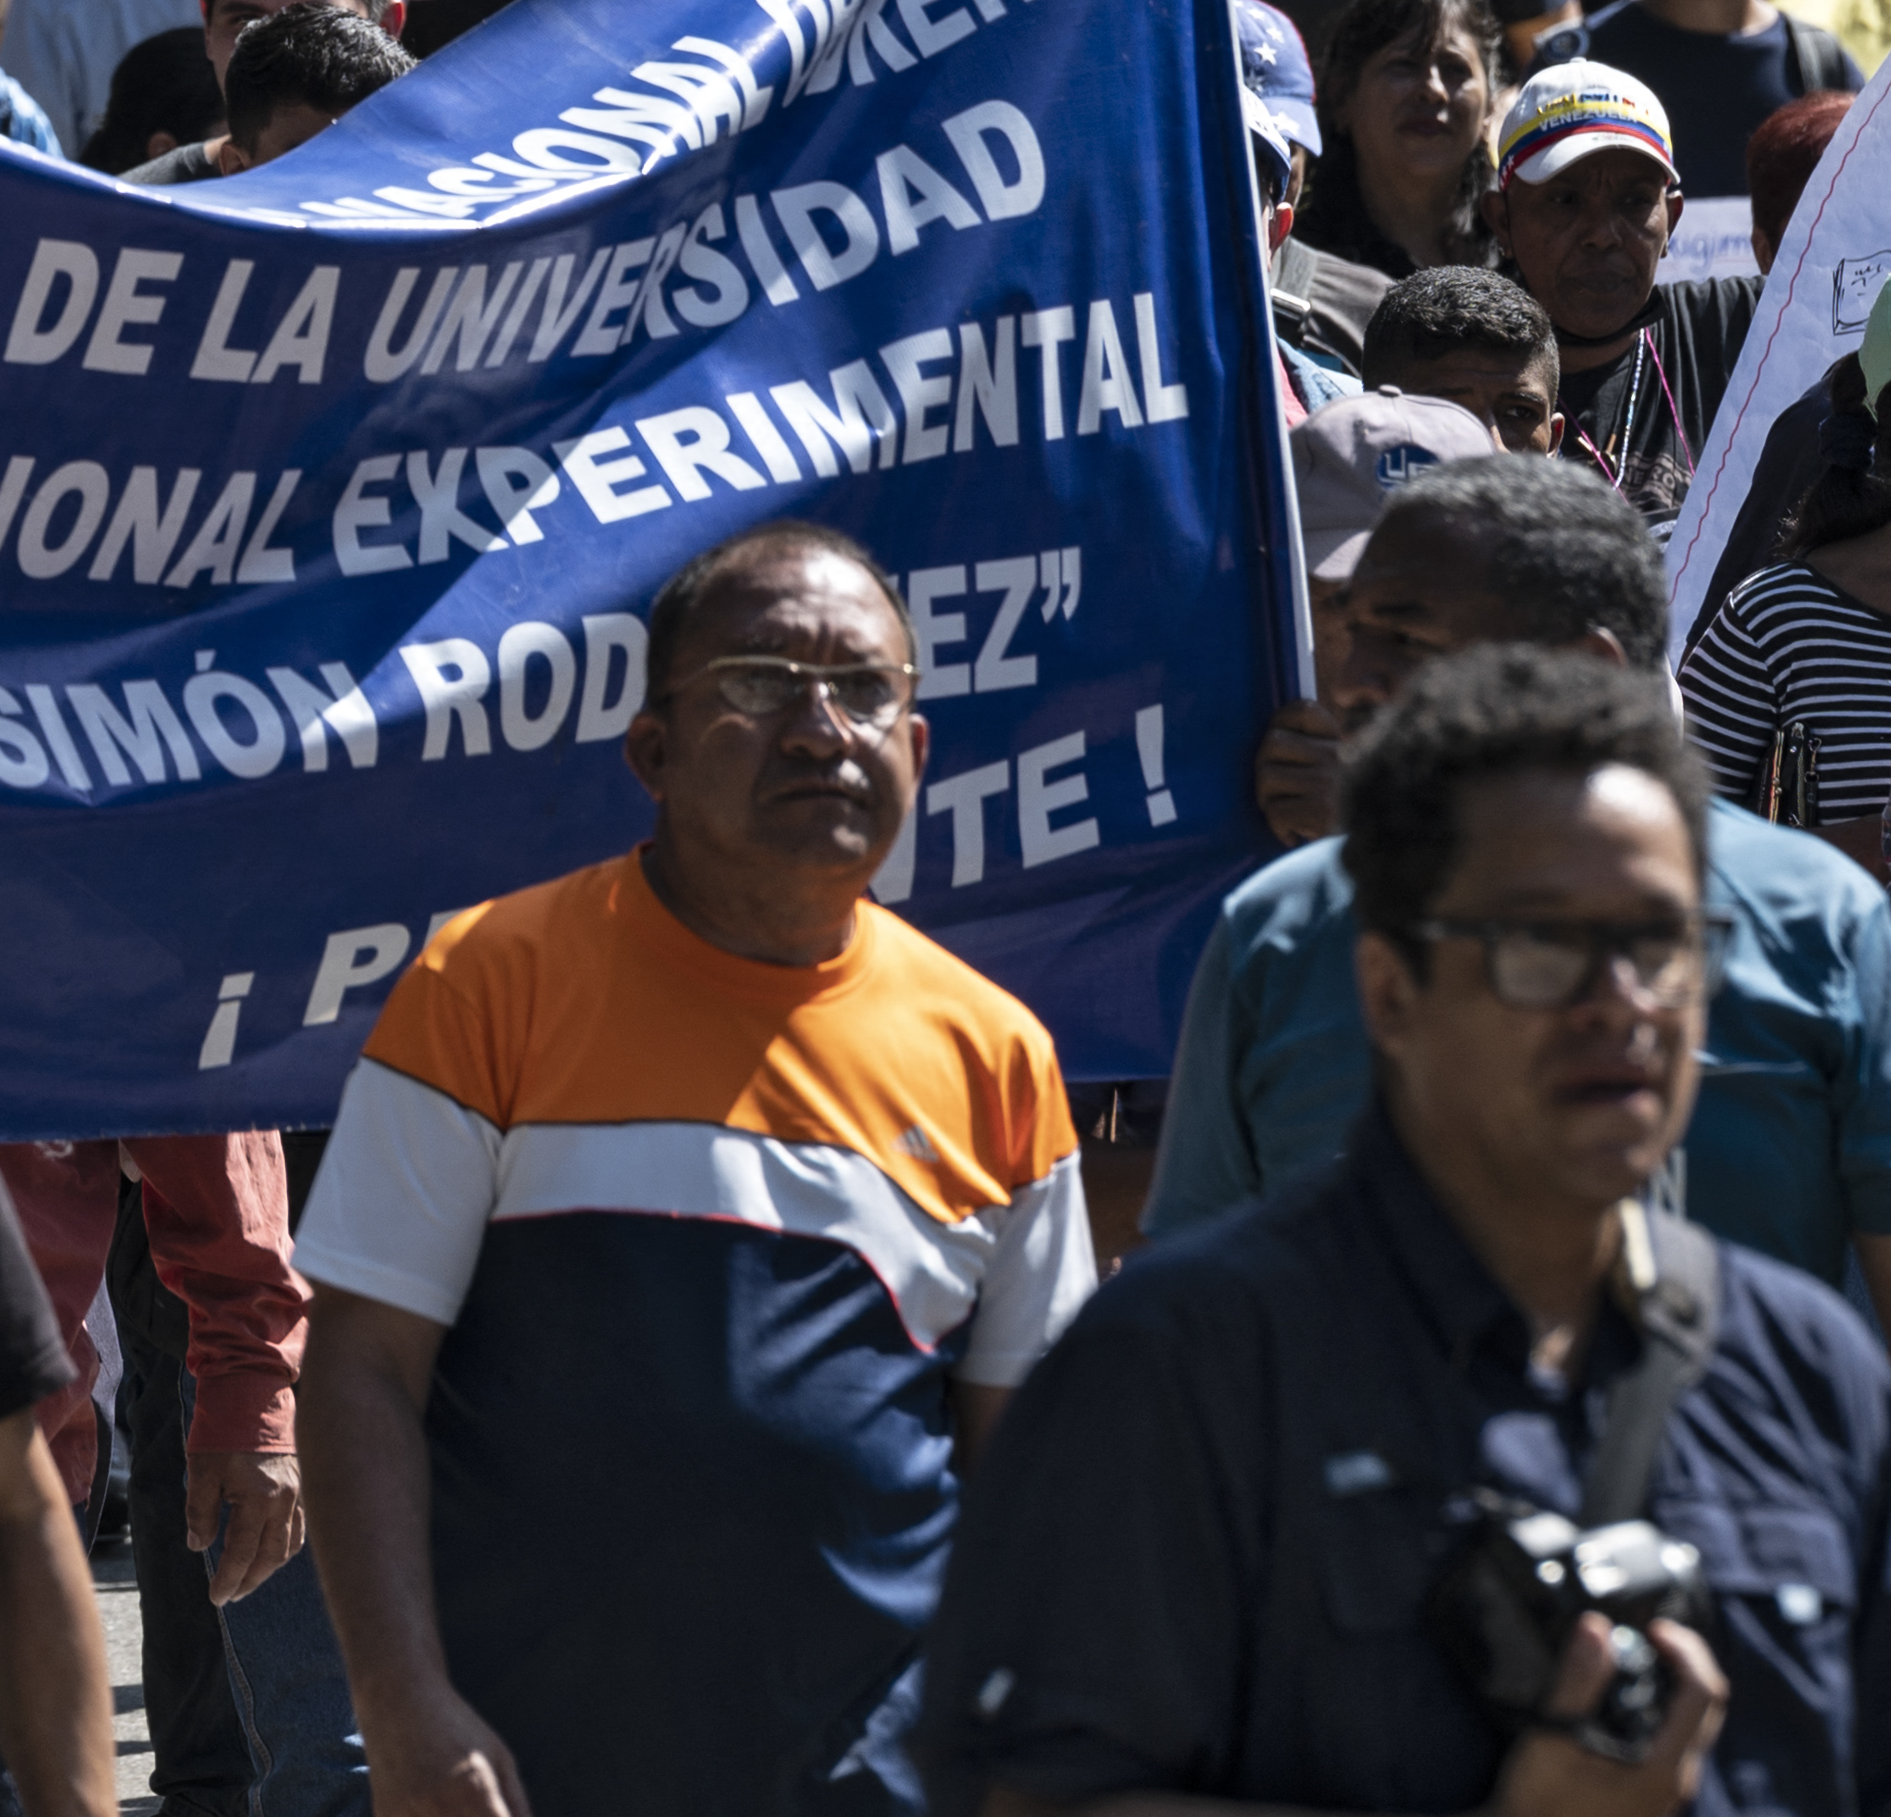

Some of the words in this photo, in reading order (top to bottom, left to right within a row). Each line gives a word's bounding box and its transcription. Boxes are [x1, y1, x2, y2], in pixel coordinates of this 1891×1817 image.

[2, 235, 181, 376] DE
[191, 258, 343, 387] LA
[361, 98, 1046, 383] UNIVERSIDAD
[1539, 108, 1639, 132] VENEZUELA
[332, 291, 1191, 580] EXPERIMENTAL
